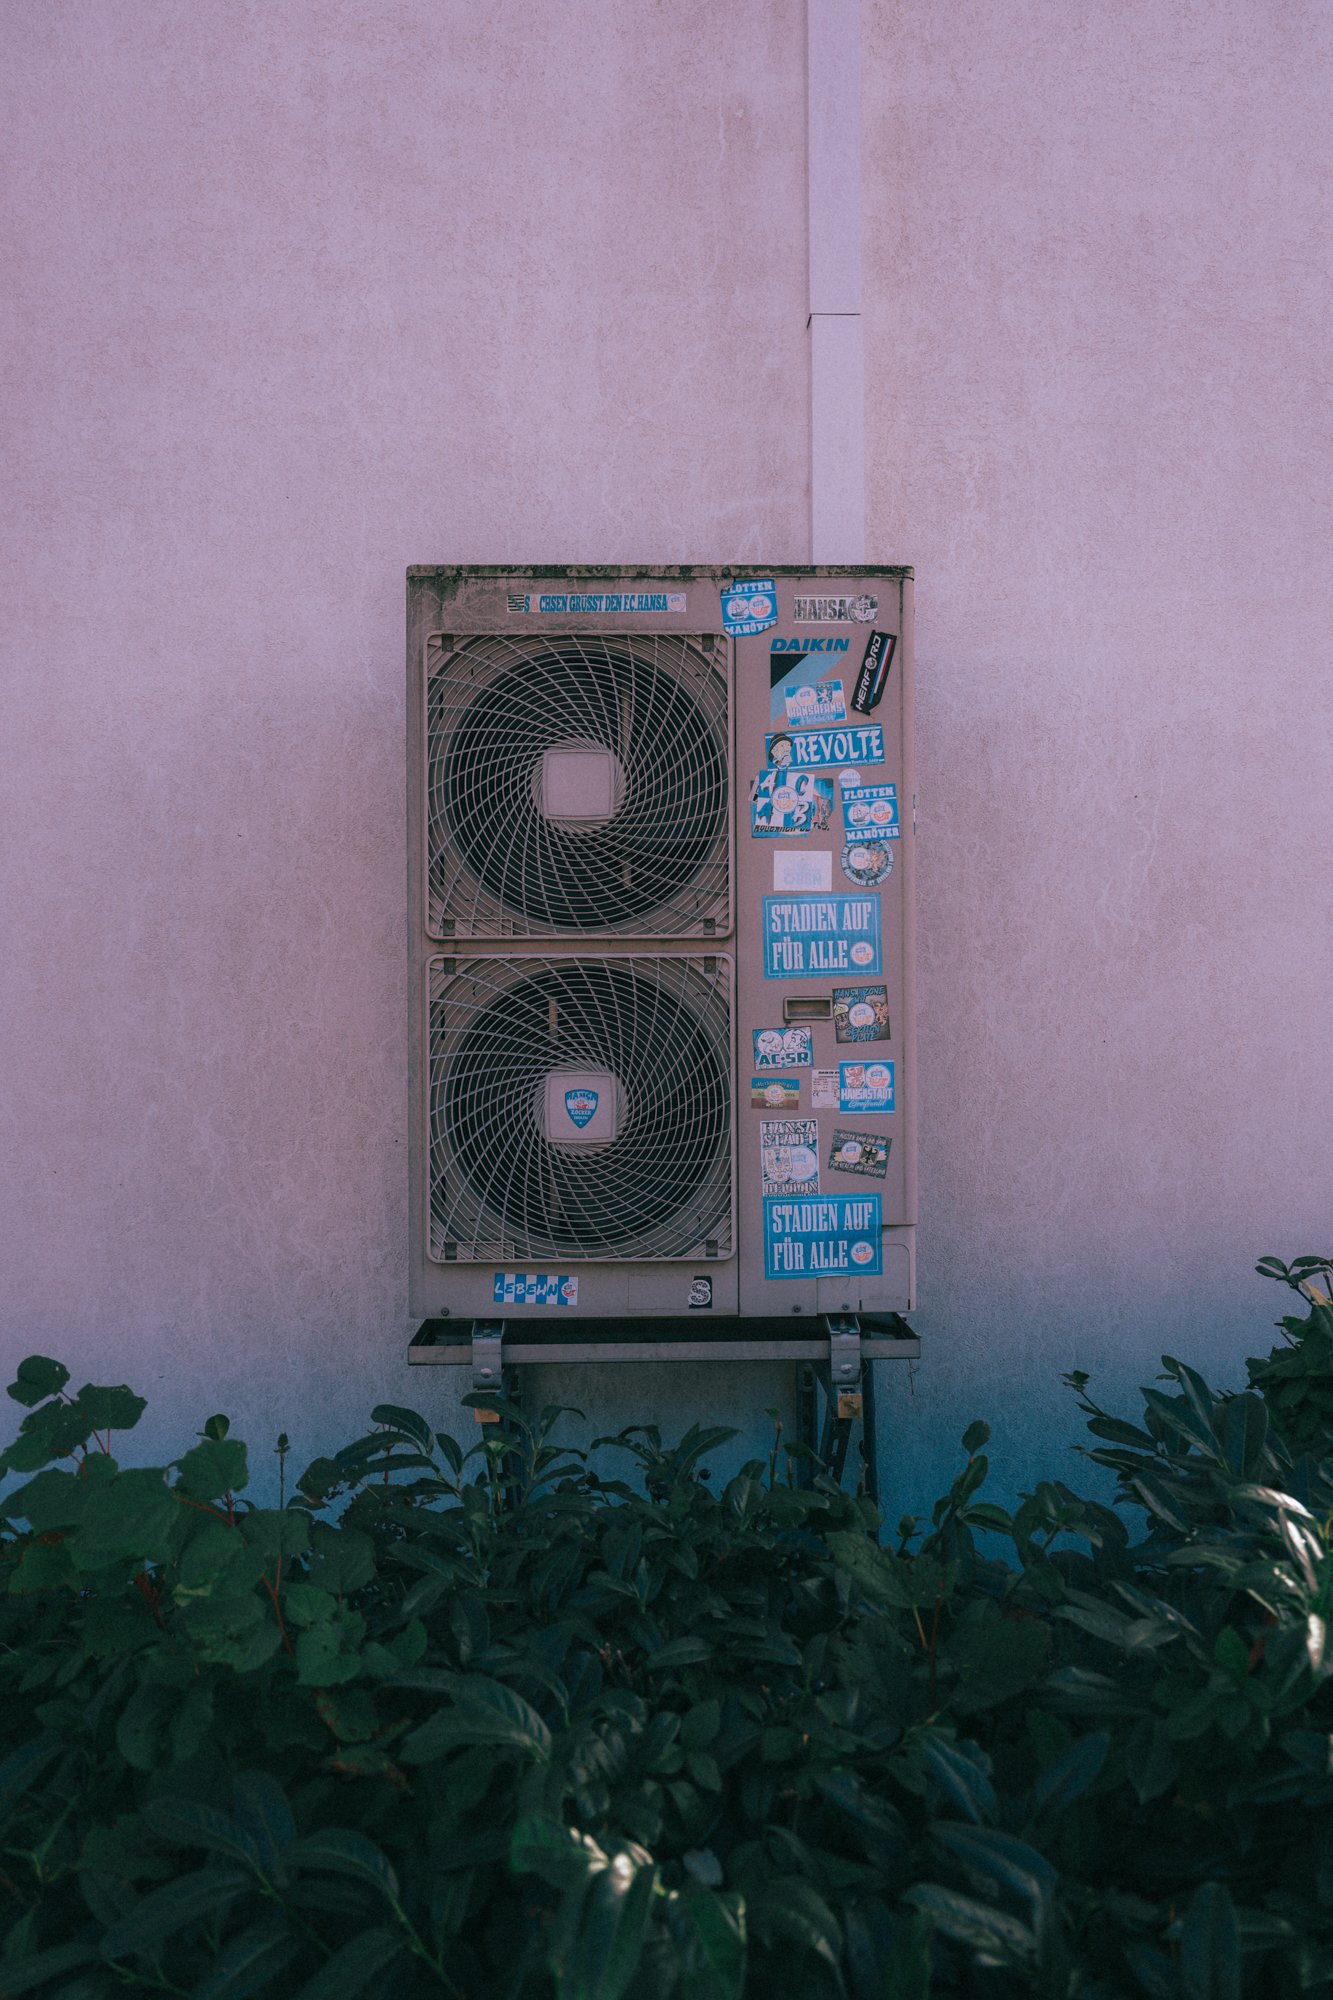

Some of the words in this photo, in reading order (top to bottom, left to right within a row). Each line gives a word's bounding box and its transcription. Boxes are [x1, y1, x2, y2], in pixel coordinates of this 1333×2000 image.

[723, 581, 772, 595] LOTTEN
[569, 594, 604, 612] GRÜSST
[605, 595, 622, 612] DEN
[796, 599, 848, 620] HANSA
[770, 638, 849, 652] DAIKIN
[793, 730, 883, 764] REVOLTE
[844, 786, 894, 800] FLOTTEN
[846, 827, 899, 841] MANÖVER
[771, 903, 837, 932] STADIEN
[842, 902, 872, 930] AUF
[772, 937, 804, 970] FÜR
[809, 940, 848, 969] ALLE
[762, 1121, 816, 1134] HANSA
[772, 1203, 838, 1233] STADIEN
[843, 1202, 873, 1230] AUF
[773, 1237, 804, 1270] FÜR
[810, 1240, 848, 1269] ALLE
[494, 1282, 558, 1296] LEBEHN
